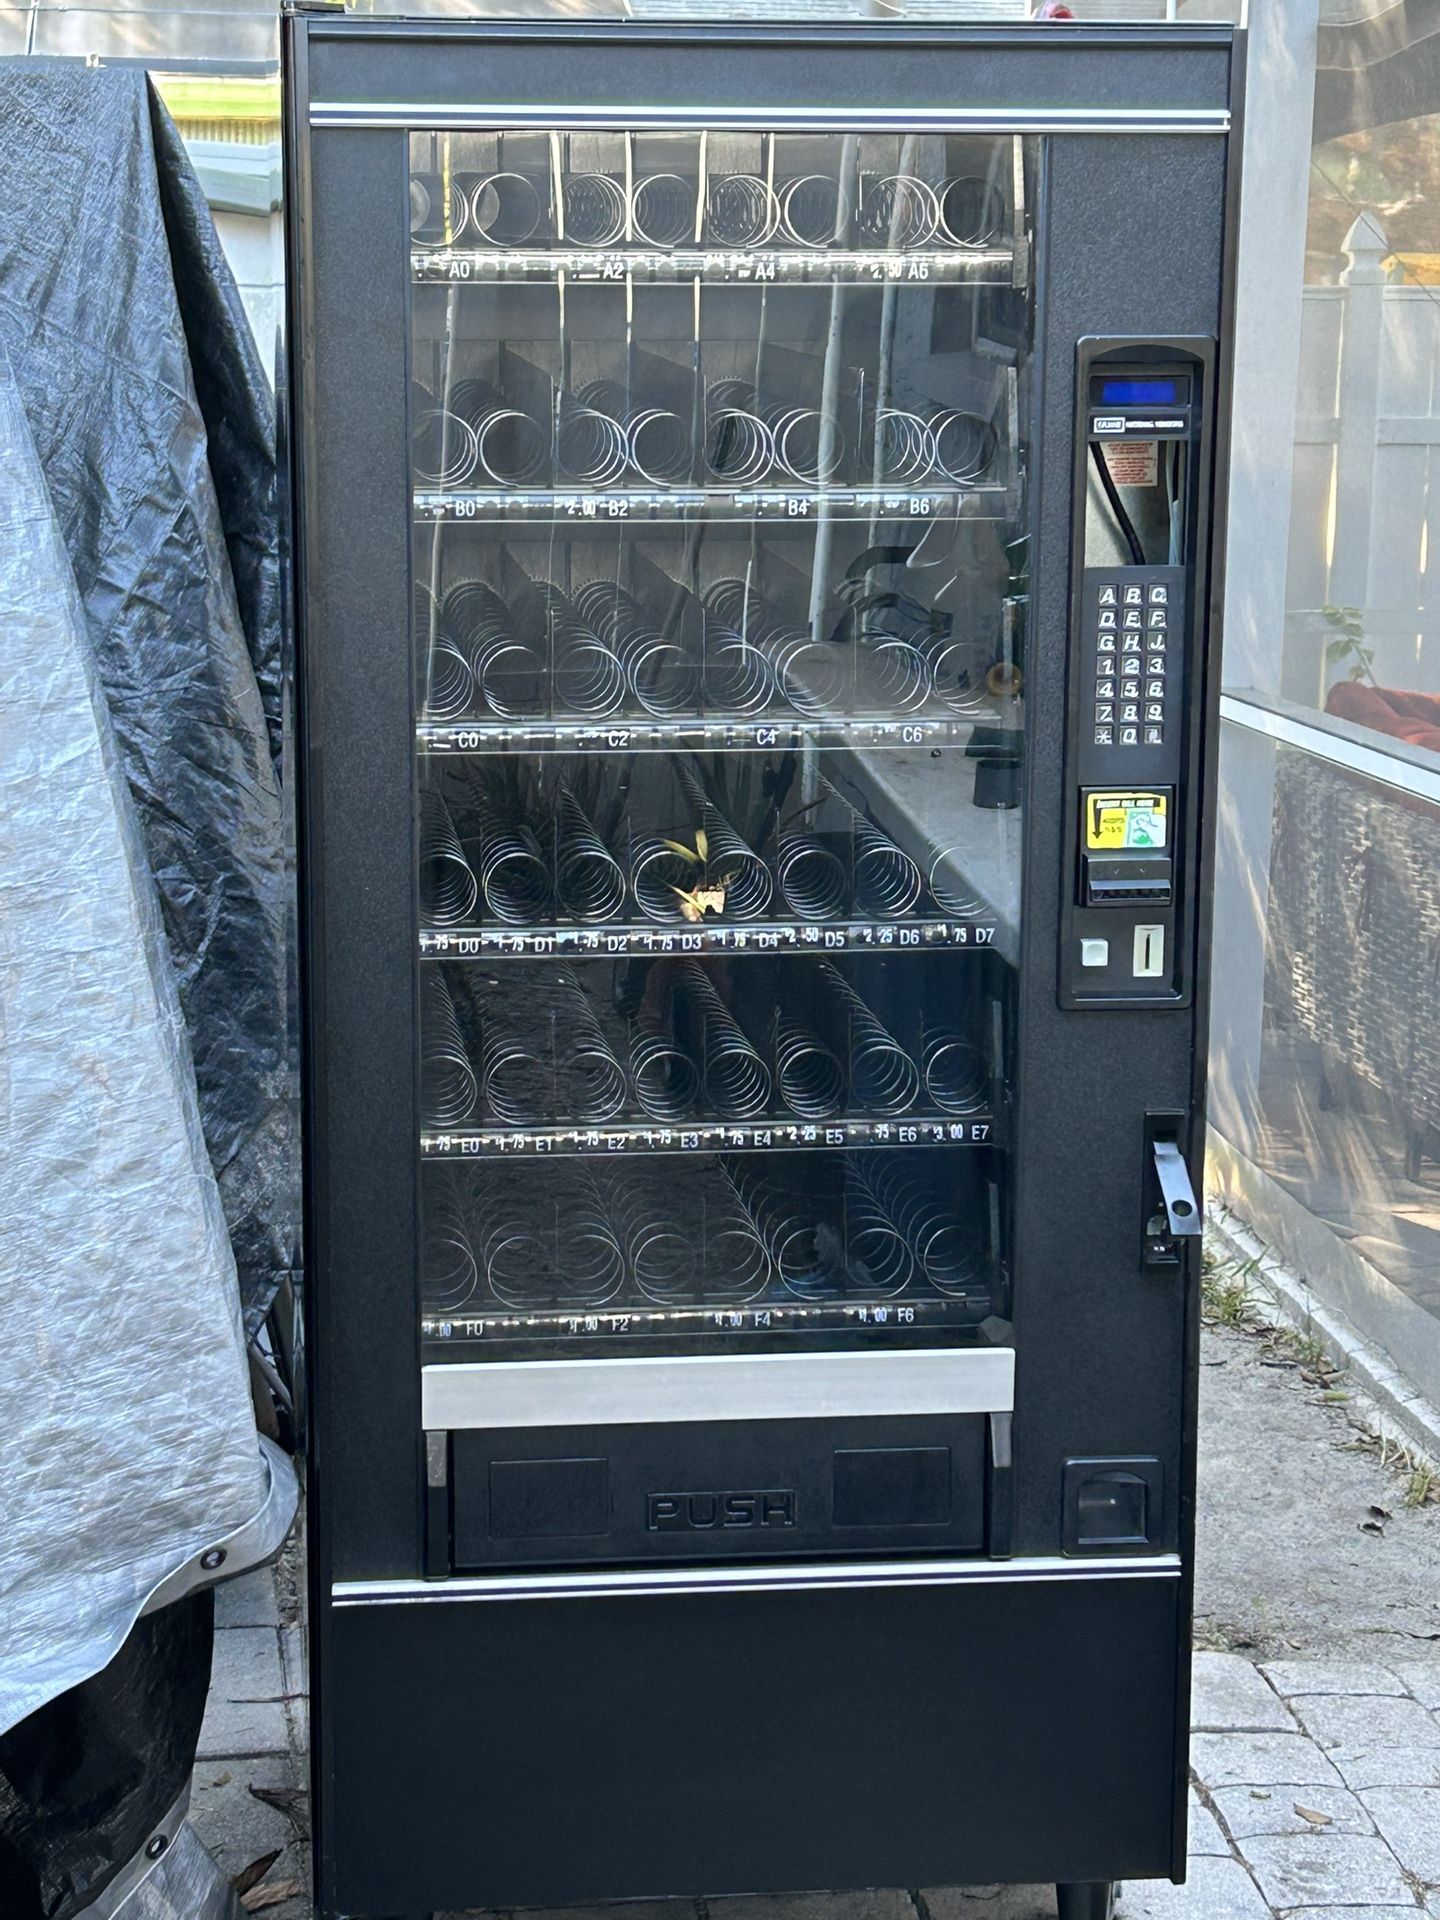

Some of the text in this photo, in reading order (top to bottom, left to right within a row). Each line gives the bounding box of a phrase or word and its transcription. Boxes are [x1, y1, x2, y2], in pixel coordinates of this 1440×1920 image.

[449, 261, 470, 278] A0
[603, 262, 624, 279] A2
[755, 263, 775, 280] A4
[908, 263, 929, 279] A6
[456, 501, 475, 517] B0
[608, 500, 628, 516] B2
[788, 499, 807, 516] B4
[910, 498, 929, 514] B6
[1100, 588, 1167, 604] A B C
[1099, 612, 1166, 628] D E F
[1099, 636, 1165, 651] G H J
[1102, 660, 1164, 675] 1 2 3
[1099, 682, 1164, 698] 4 5 6
[1100, 706, 1162, 721] 7 8 9
[458, 732, 479, 748] C0
[608, 731, 628, 747] C2
[756, 729, 776, 745] C4
[903, 726, 922, 742] C6
[1122, 730, 1137, 744] 0
[459, 938, 479, 953] D0
[534, 936, 553, 951] D1
[608, 935, 627, 951] D2
[682, 934, 702, 949] D3
[758, 933, 778, 947] D4
[825, 931, 845, 947] D5
[900, 929, 919, 944] D6
[975, 928, 995, 943] D7
[461, 1138, 480, 1153] E0
[535, 1137, 552, 1151] E1
[608, 1135, 625, 1149] E2
[681, 1133, 699, 1148] E3
[754, 1131, 771, 1146] E4
[826, 1128, 844, 1144] E5
[899, 1126, 917, 1142] E6
[972, 1125, 989, 1140] E7
[754, 1312, 771, 1327] F4
[897, 1308, 914, 1323] F6
[466, 1321, 483, 1336] F0
[612, 1317, 629, 1332] F2
[648, 1493, 793, 1530] PUSH
